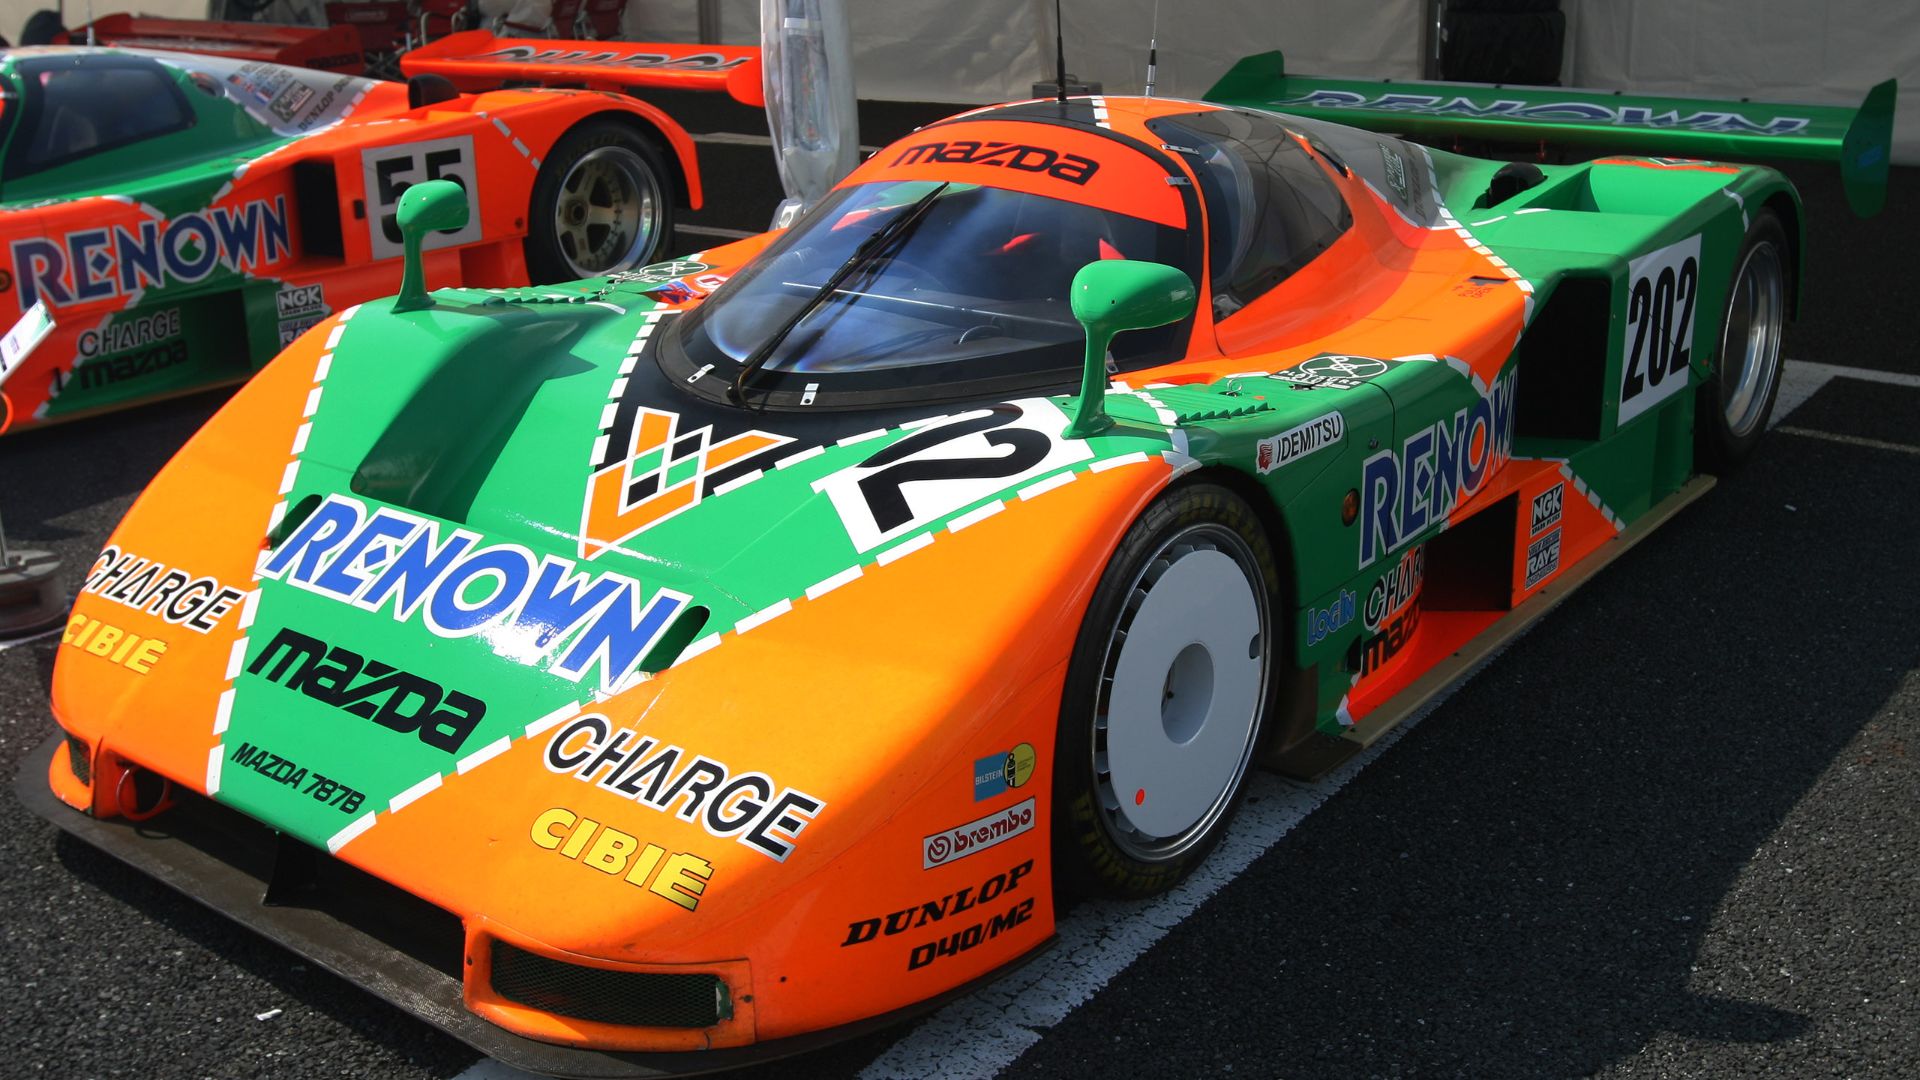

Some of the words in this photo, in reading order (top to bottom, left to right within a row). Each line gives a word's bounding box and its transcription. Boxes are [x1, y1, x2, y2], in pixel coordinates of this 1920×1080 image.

[10, 194, 292, 313] RENOWN
[78, 308, 182, 359] CHARGE
[279, 286, 321, 310] NGK
[1621, 257, 1698, 402] 202
[1276, 415, 1341, 463] IDEMITSU
[1532, 486, 1562, 525] NGK
[82, 545, 247, 635] CHARGE
[254, 493, 693, 700] RENOWN
[231, 742, 305, 790] MAZDA
[309, 773, 366, 815] 787B
[544, 713, 826, 863] CHARGE
[975, 769, 1003, 786] BILSTEIN
[954, 805, 1032, 852] brembo
[841, 860, 1034, 947] DUNLOP
[908, 897, 1035, 971] D40/M2
